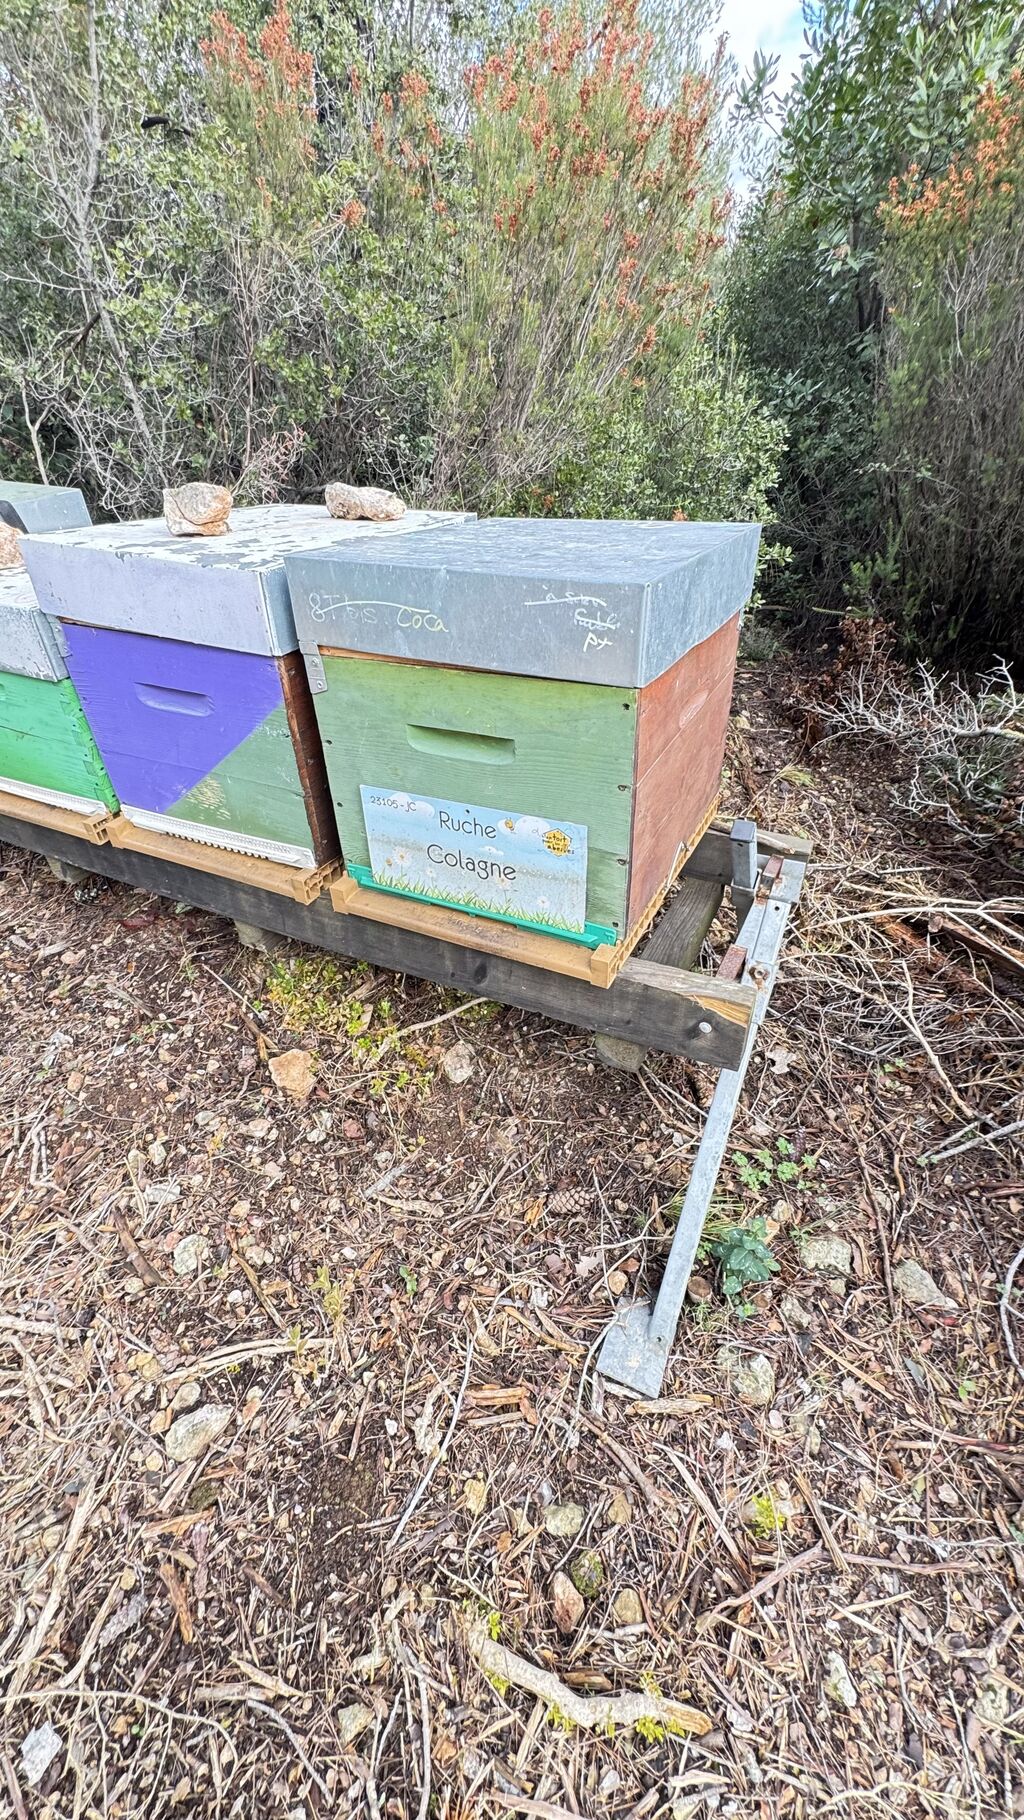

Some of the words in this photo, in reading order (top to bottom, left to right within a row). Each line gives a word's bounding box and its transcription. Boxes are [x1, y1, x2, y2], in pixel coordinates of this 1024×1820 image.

[370, 795, 417, 813] 23105-JC
[439, 810, 497, 839] Ruche
[426, 843, 517, 881] Colagne
